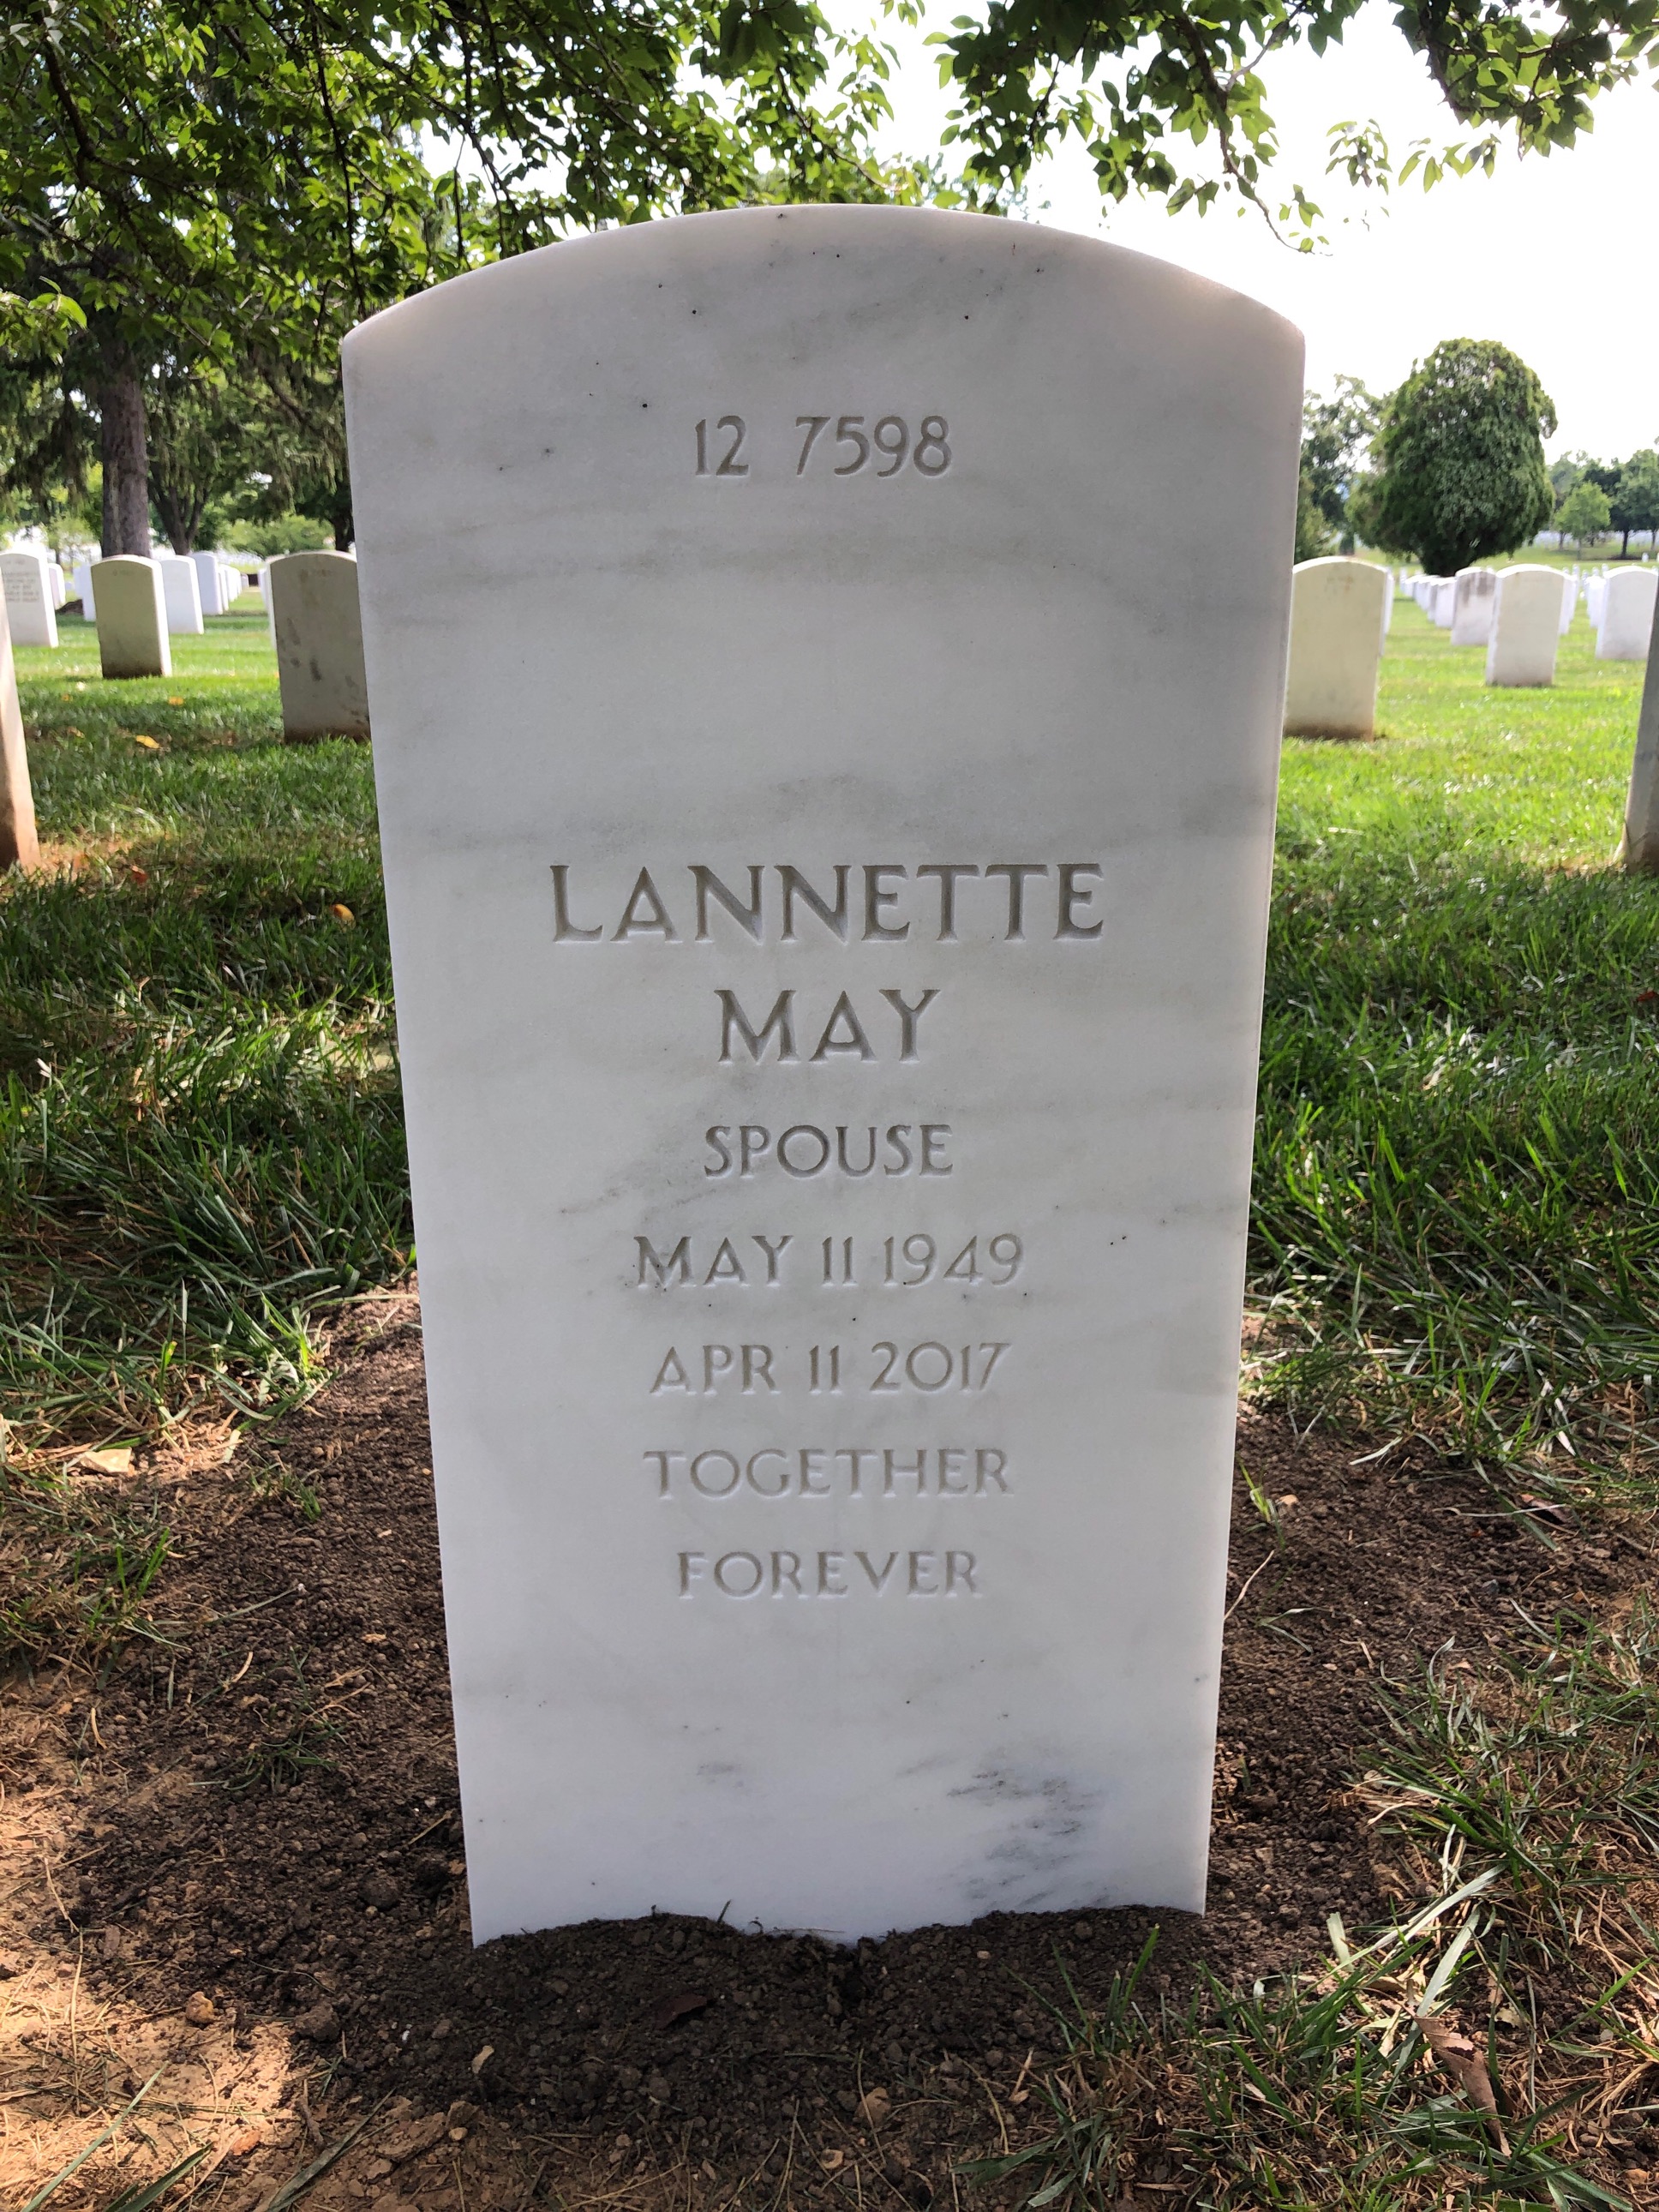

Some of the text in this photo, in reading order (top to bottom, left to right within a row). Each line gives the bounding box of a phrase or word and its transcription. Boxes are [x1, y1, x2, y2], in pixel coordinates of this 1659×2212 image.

[695, 415, 952, 477] 12 7598
[550, 863, 1105, 944] LANNETTE
[714, 989, 941, 1064] MAY
[704, 1124, 955, 1178] SPOUSE
[633, 1233, 1024, 1287] MAY 11 1949
[650, 1341, 1012, 1395] APR 11 2017
[644, 1448, 1015, 1500] TOGETHER
[677, 1550, 983, 1600] FOREVER
